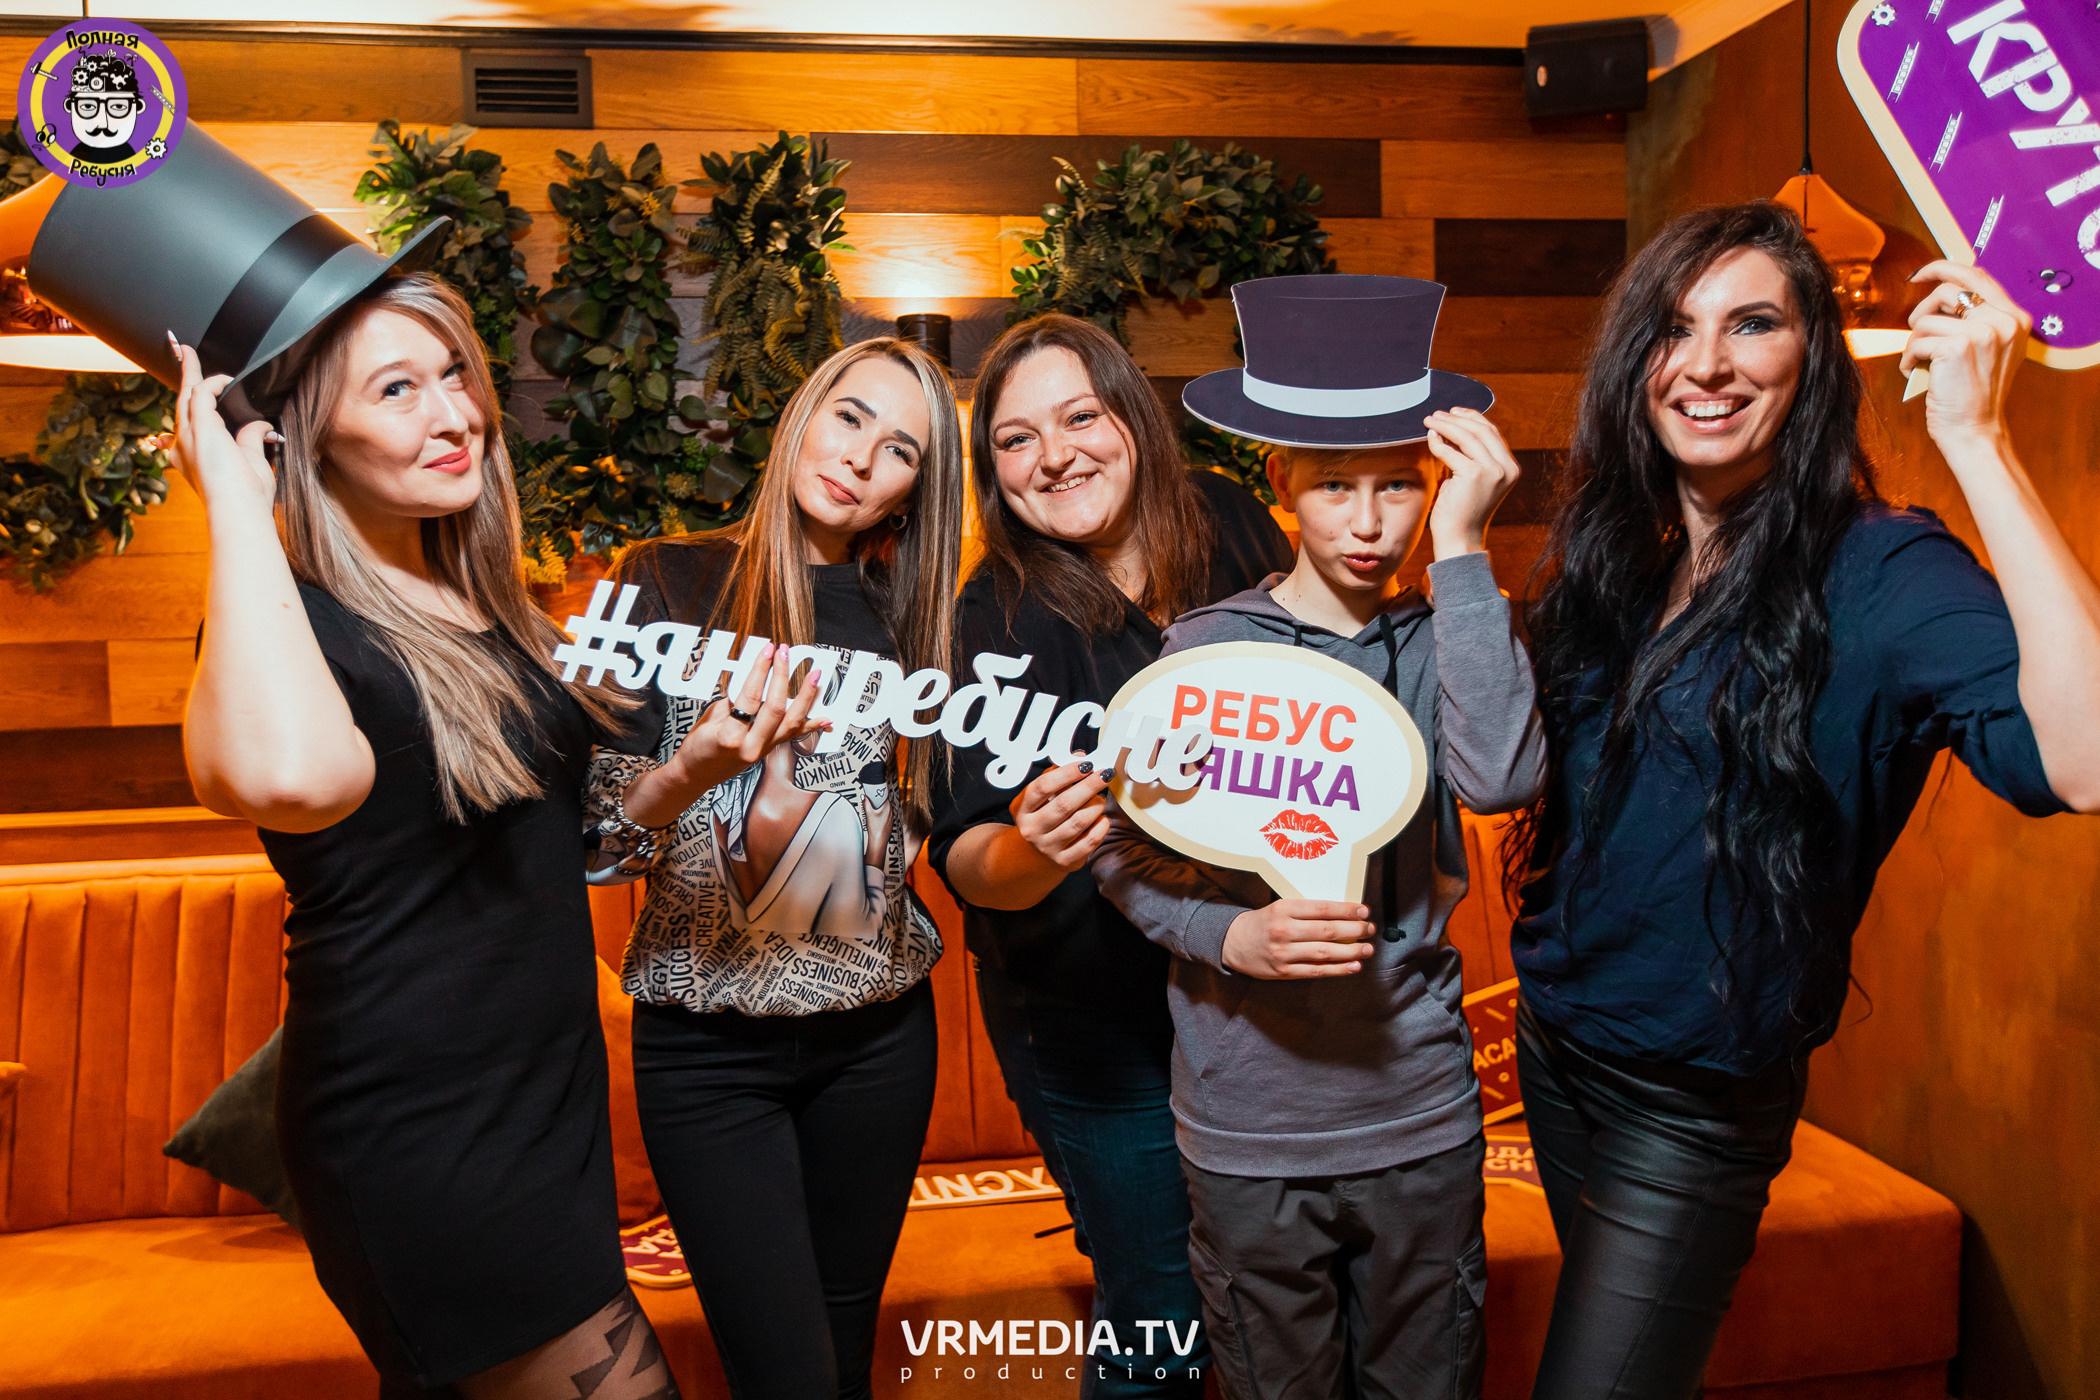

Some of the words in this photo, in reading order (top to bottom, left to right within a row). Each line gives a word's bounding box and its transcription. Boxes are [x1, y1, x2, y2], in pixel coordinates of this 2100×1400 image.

[1170, 684, 1357, 753] РЕБУС
[695, 881, 716, 947] CREATIVE
[668, 912, 696, 1000] SUCCESS
[764, 931, 797, 965] IDEA
[706, 945, 759, 1000] INSPIRATION
[756, 965, 781, 1001] INSPIRATION
[779, 978, 832, 1010] BUSINESS
[791, 957, 861, 989] BUSINESS
